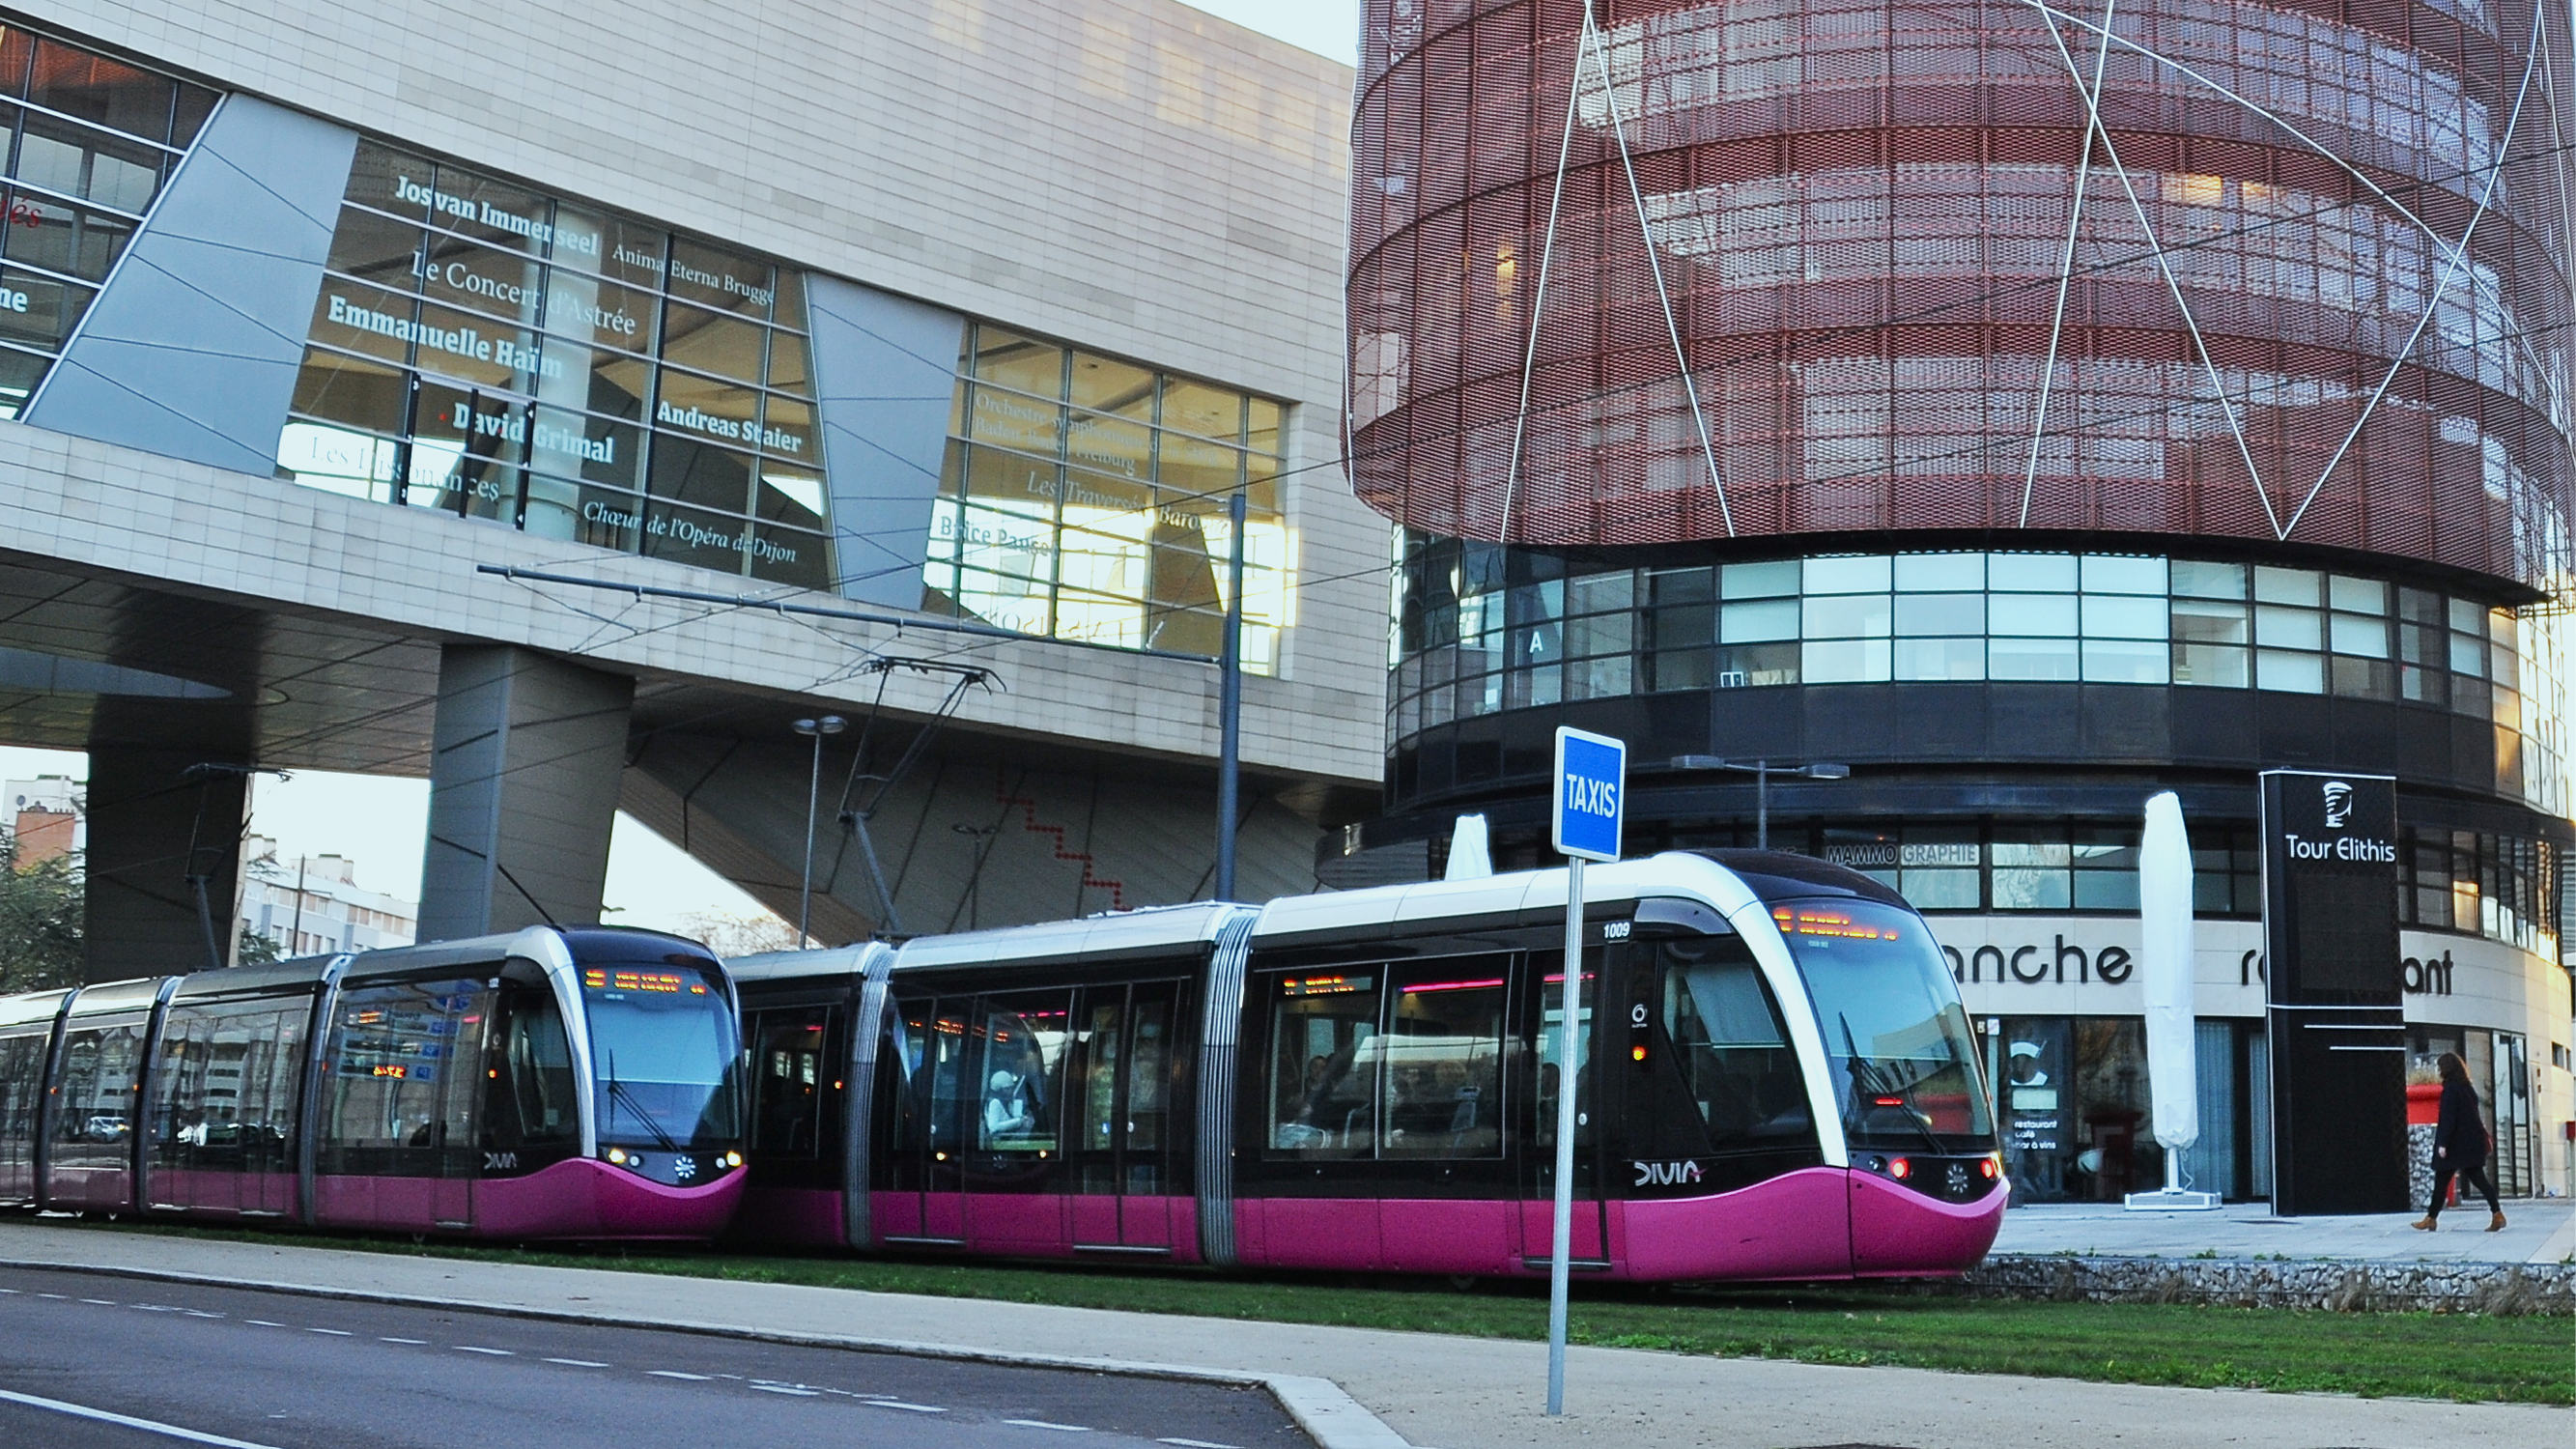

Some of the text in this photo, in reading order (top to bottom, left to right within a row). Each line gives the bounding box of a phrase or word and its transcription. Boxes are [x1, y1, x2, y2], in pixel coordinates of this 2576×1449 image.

[480, 201, 598, 256] Immerseel
[410, 251, 439, 281] Le
[446, 263, 540, 309] Concert
[612, 243, 665, 272] Anima
[670, 260, 719, 289] Eterna
[327, 295, 562, 379] Emmanuelle Haïm
[453, 402, 614, 465] David Grimal
[657, 401, 802, 453] Andreas Staier
[1027, 470, 1057, 497] Les
[646, 515, 666, 536] de
[669, 517, 728, 549] l'Opéra
[732, 533, 752, 553] de
[752, 538, 796, 565] Dijon
[1529, 630, 1543, 654] A
[1566, 773, 1616, 818] TAXIS
[2284, 834, 2396, 863] Tour Elithis
[1604, 921, 1630, 939] 1009
[2014, 1120, 2057, 1129] restaurant
[2039, 1140, 2056, 1150] vins
